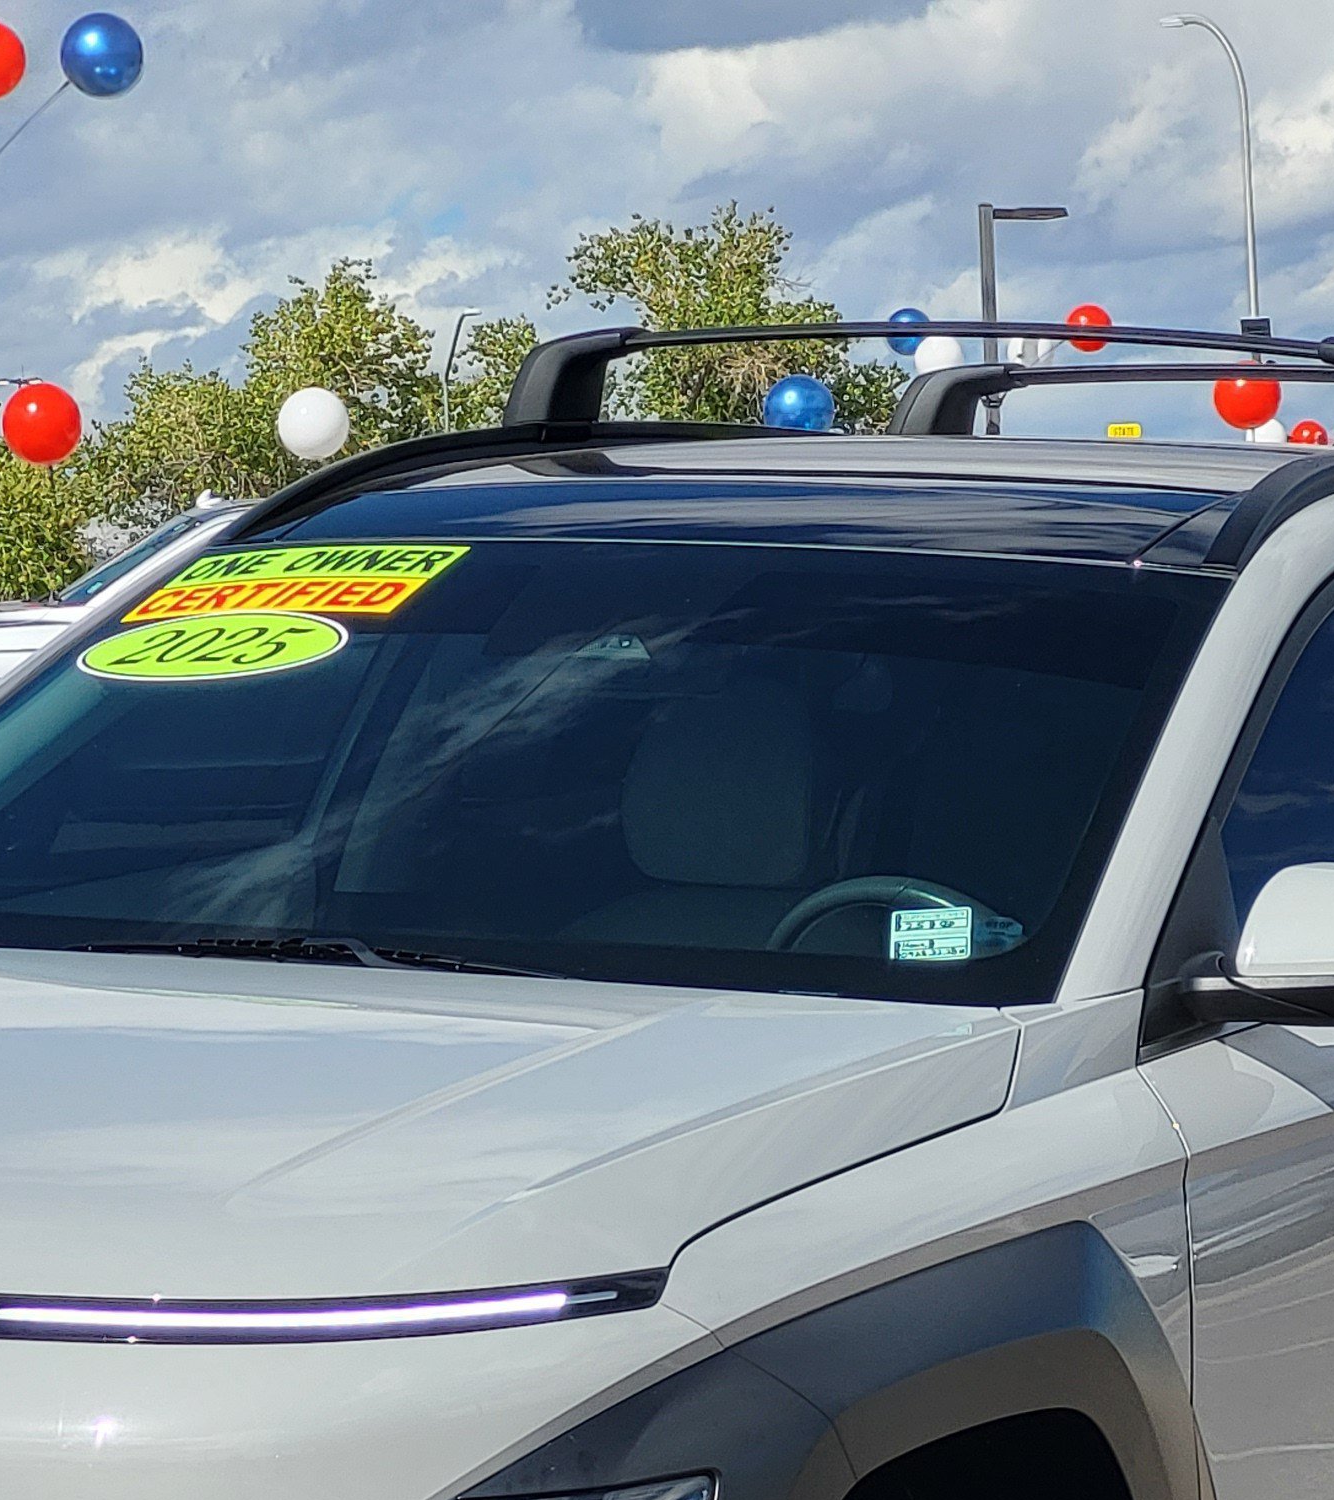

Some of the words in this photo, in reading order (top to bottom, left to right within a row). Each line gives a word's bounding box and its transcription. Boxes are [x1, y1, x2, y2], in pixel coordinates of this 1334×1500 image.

[183, 551, 286, 582] ONE
[282, 549, 454, 575] OWNER
[135, 580, 410, 616] CERTIFIED
[110, 626, 317, 667] 2025
